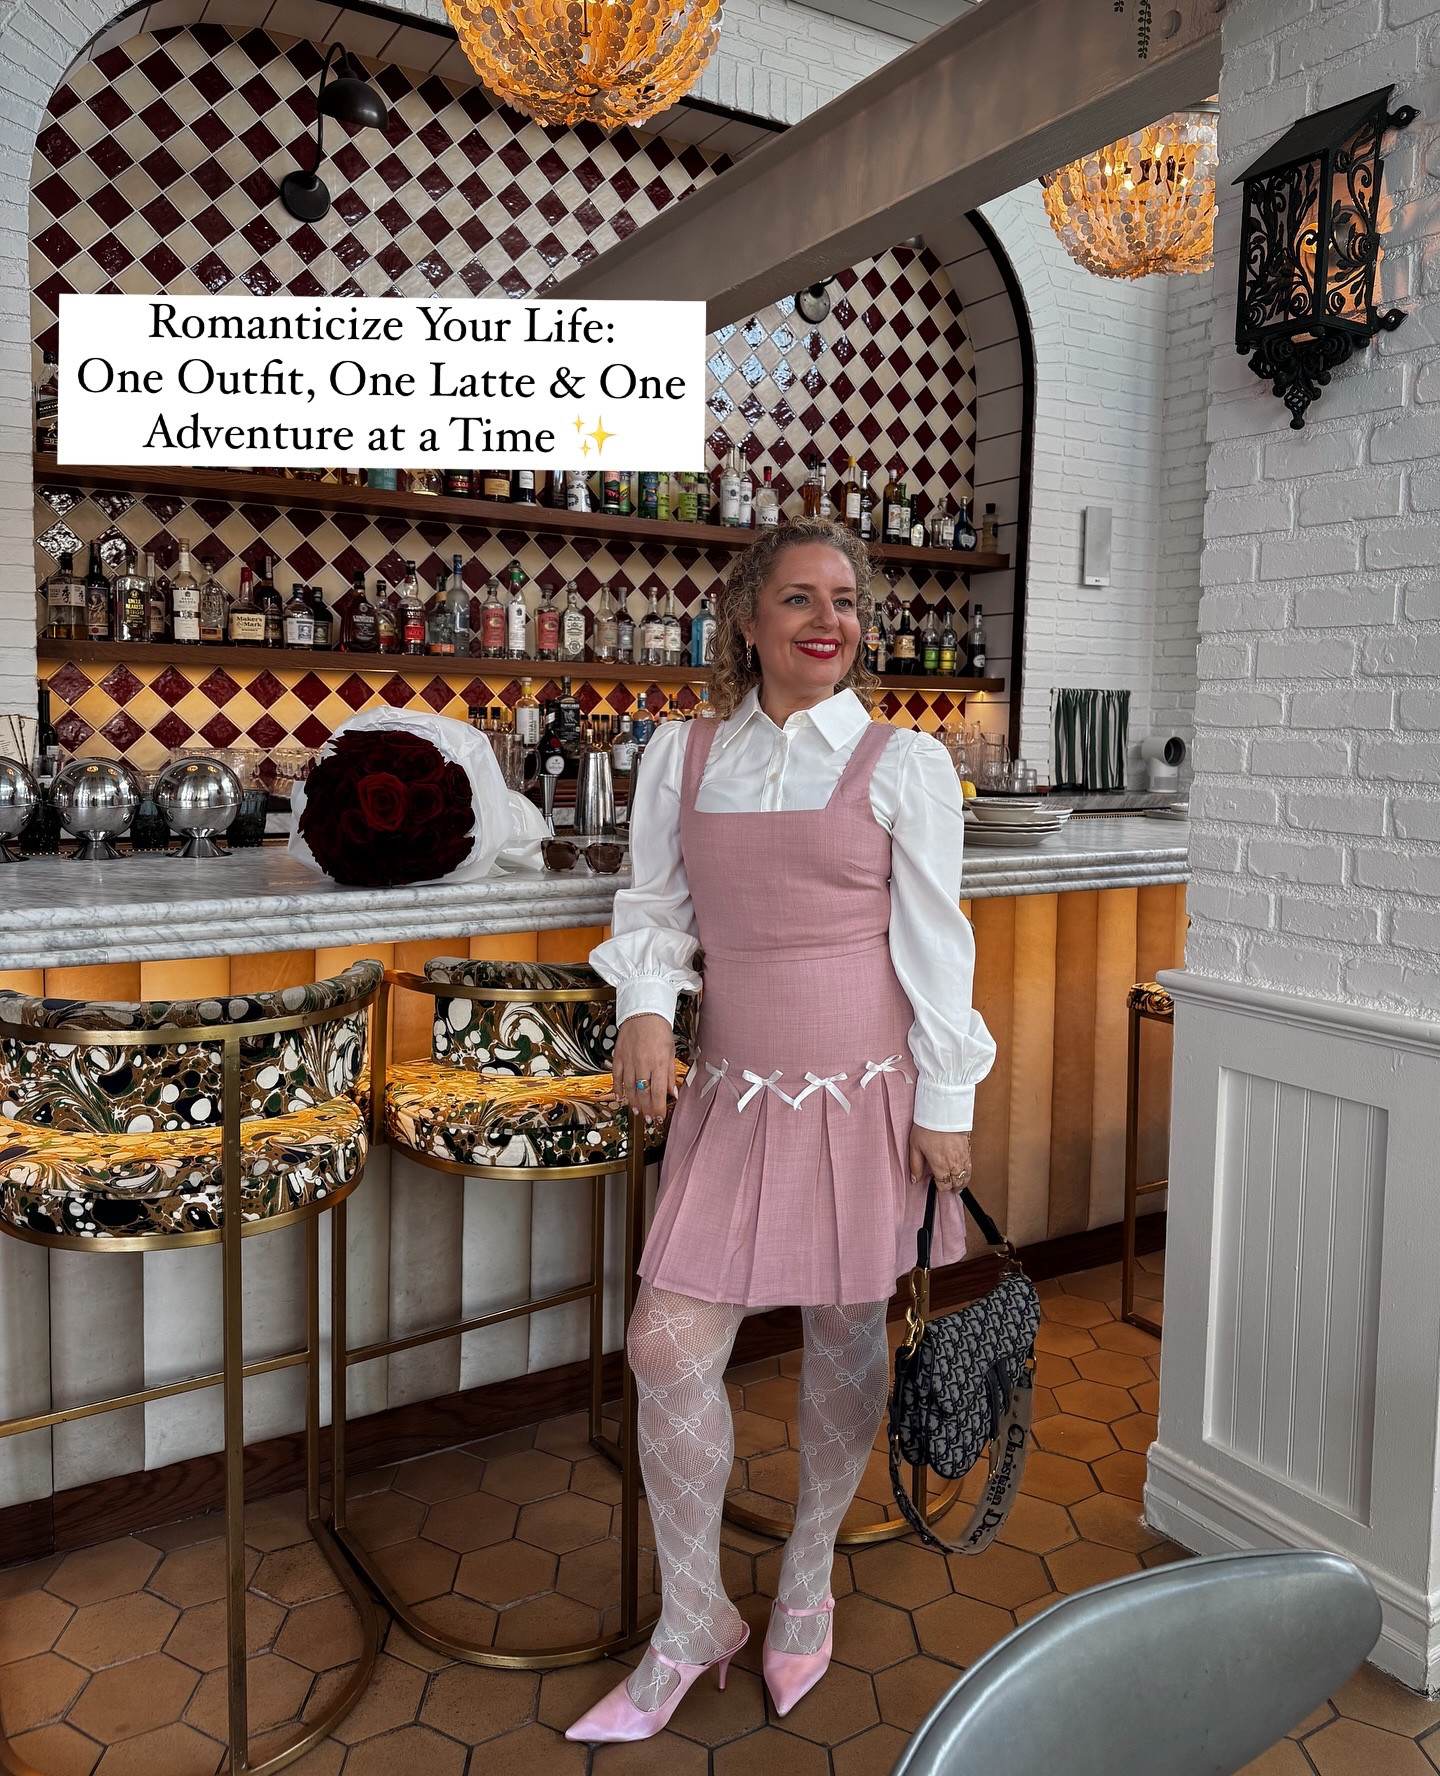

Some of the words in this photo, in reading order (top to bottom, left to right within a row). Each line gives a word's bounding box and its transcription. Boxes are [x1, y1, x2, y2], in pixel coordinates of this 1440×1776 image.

[990, 1423, 1025, 1506] Christian
[986, 1473, 1000, 1502] PARIS
[968, 1508, 1004, 1545] Dior
